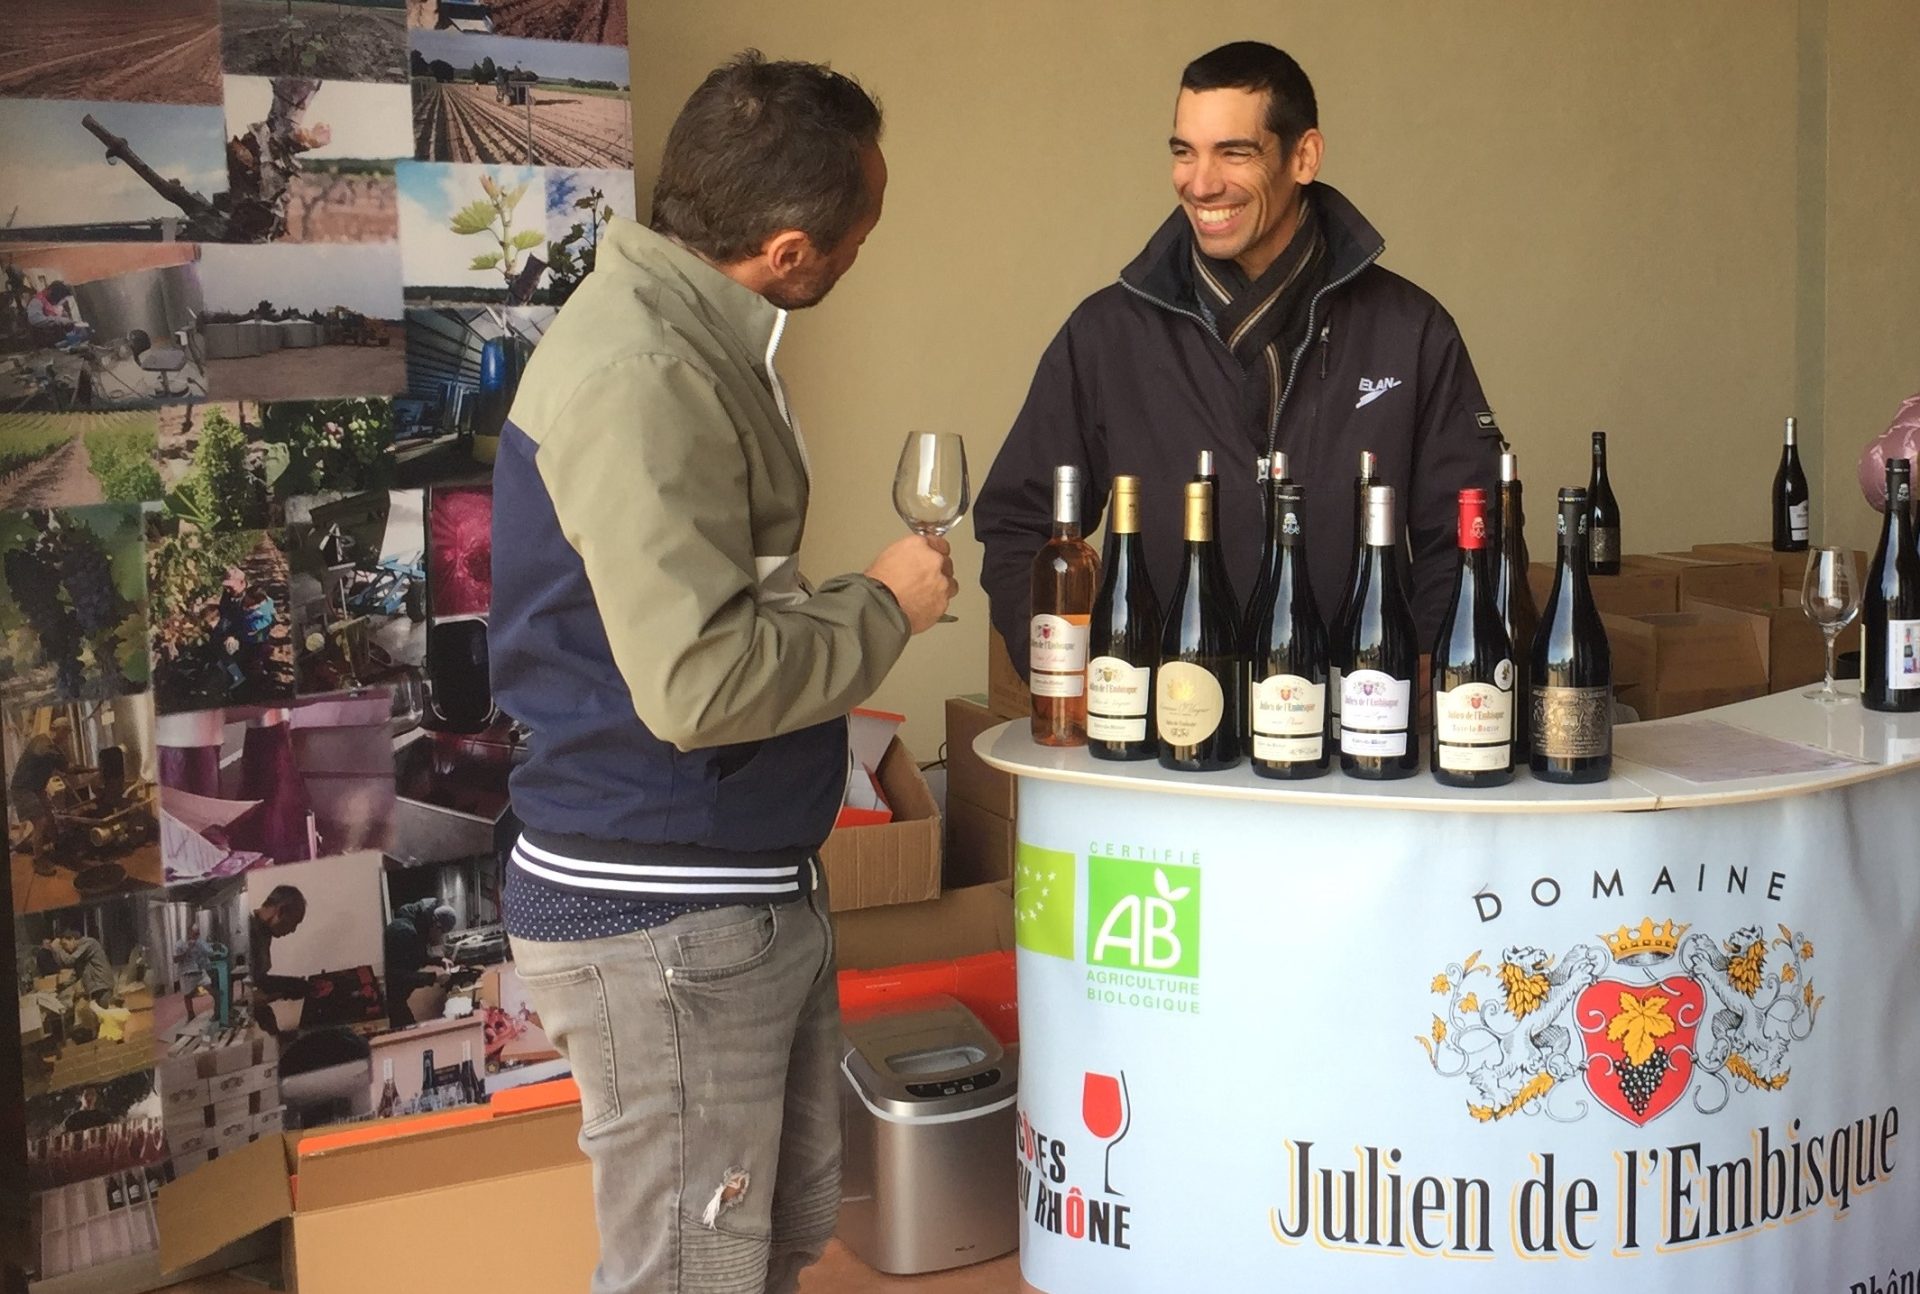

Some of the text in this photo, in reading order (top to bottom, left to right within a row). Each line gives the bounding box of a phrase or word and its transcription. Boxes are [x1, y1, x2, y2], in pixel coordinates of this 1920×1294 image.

[1358, 377, 1394, 392] ELAN
[1089, 840, 1201, 866] CERTIFIÉ
[1473, 863, 1787, 923] DOMAINE
[1093, 893, 1182, 970] AB
[1086, 969, 1200, 996] AGRICULTURE
[1087, 986, 1200, 1015] BIOLOGIQUE
[1273, 1105, 1899, 1258] Julien de l'Embisque
[1034, 1179, 1131, 1251] RHÔNE
[1849, 1268, 1920, 1294] hôn
